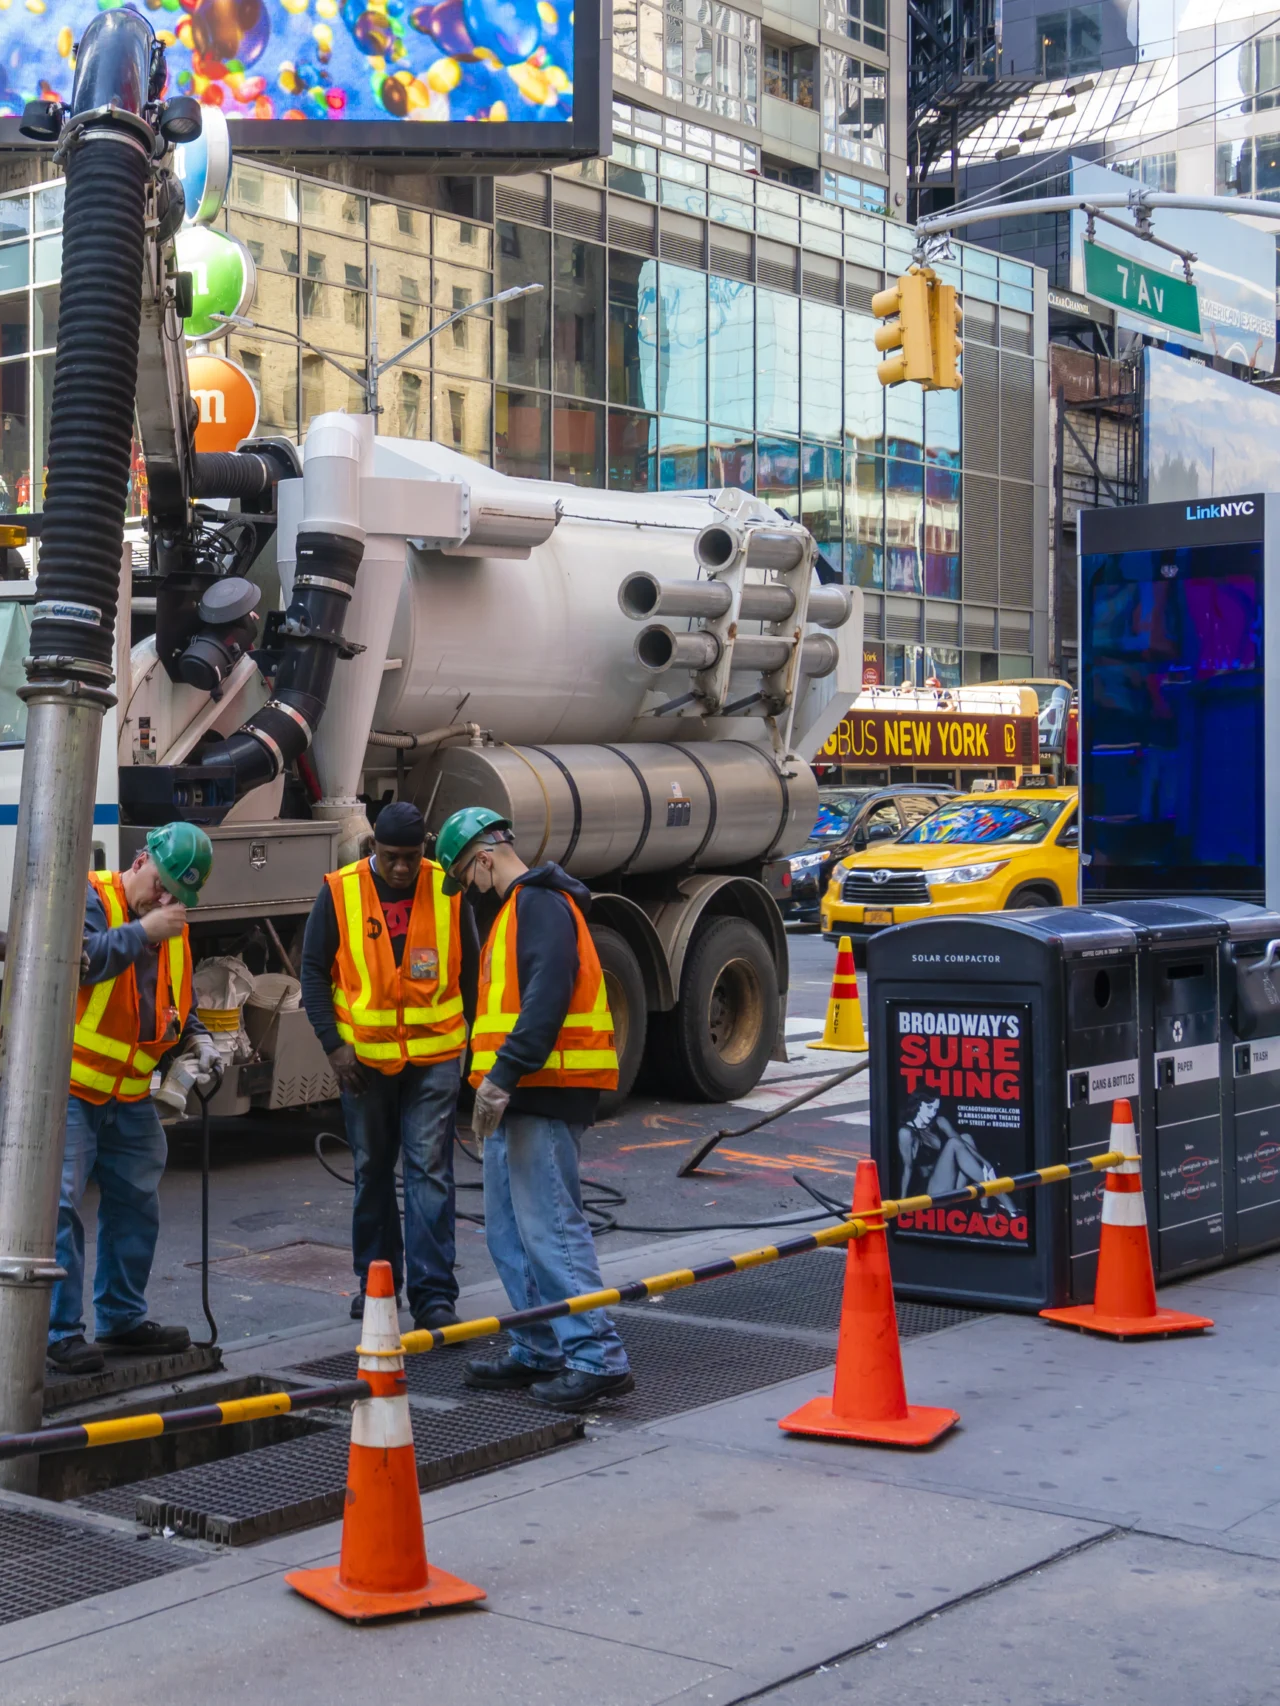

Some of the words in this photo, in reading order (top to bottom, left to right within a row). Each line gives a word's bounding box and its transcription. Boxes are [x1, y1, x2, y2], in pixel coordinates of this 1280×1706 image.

[1117, 264, 1129, 299] 7
[1138, 274, 1164, 313] AV
[1240, 312, 1276, 338] EXPRESS
[1186, 500, 1255, 520] LinkNYC
[884, 720, 931, 757] NEW
[937, 721, 989, 757] YORK
[912, 954, 941, 962] SOLAR
[944, 954, 1001, 963] COMPACTOR
[899, 1011, 1019, 1038] BROADWAY'S
[900, 1034, 1020, 1071] SURE
[1253, 1050, 1269, 1063] TRASH
[1177, 1060, 1193, 1072] PAPER
[900, 1067, 1020, 1100] THING
[1092, 1079, 1107, 1091] CANS
[1107, 1078, 1112, 1088] &
[1112, 1073, 1135, 1088] BOTTLES
[963, 1112, 997, 1120] AMBASSADOR
[992, 1121, 1020, 1129] BROADWAY
[897, 1209, 1028, 1240] CHICAGO
